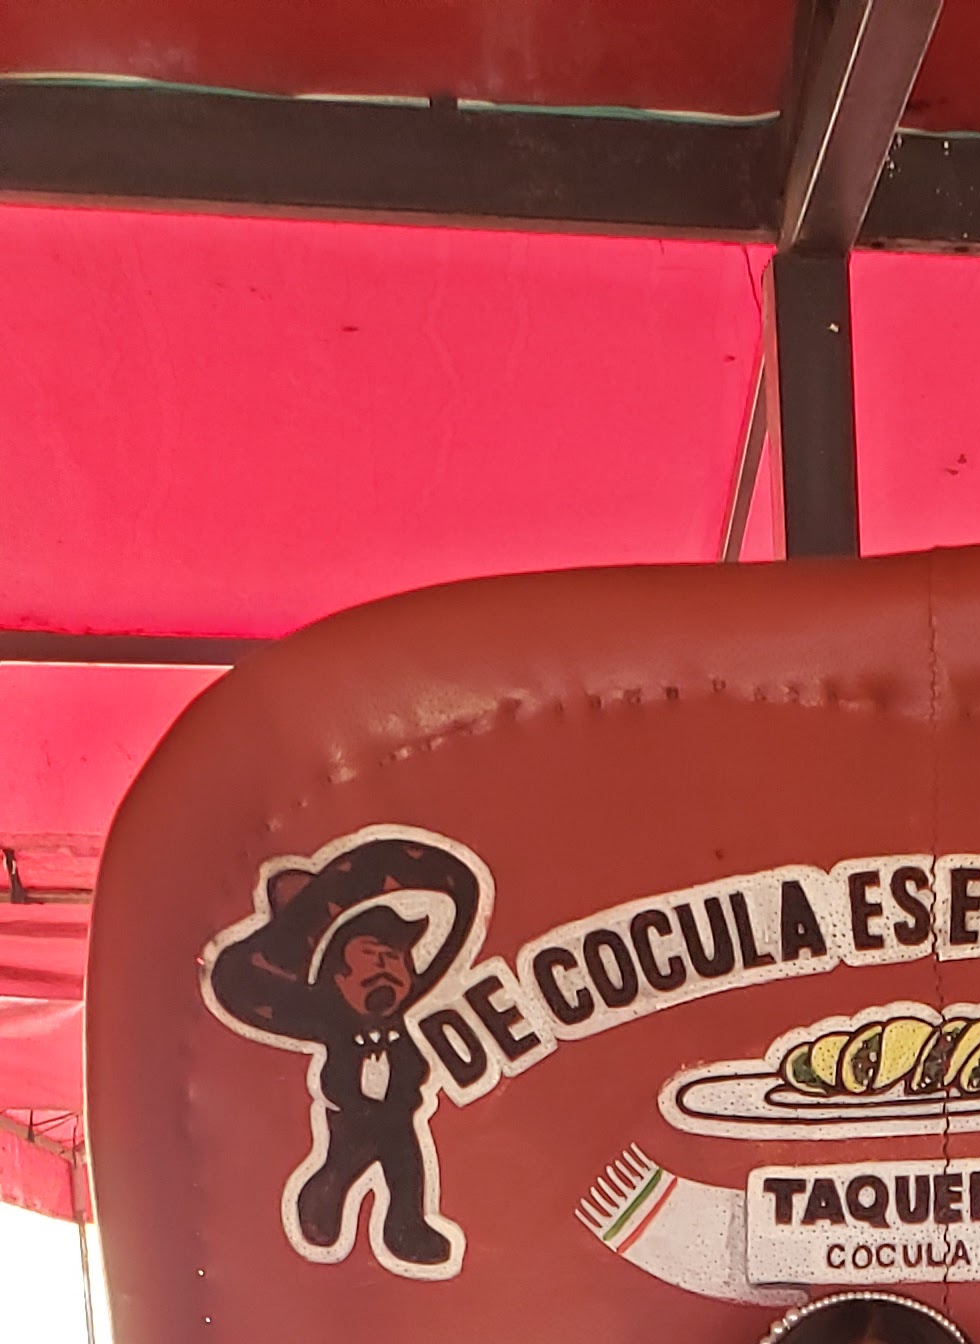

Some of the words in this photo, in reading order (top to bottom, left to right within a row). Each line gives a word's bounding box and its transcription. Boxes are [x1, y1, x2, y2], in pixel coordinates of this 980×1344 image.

[418, 975, 541, 1087] DE
[532, 880, 828, 1026] COCULA
[847, 866, 932, 951] ES
[826, 1240, 971, 1269] COCULA
